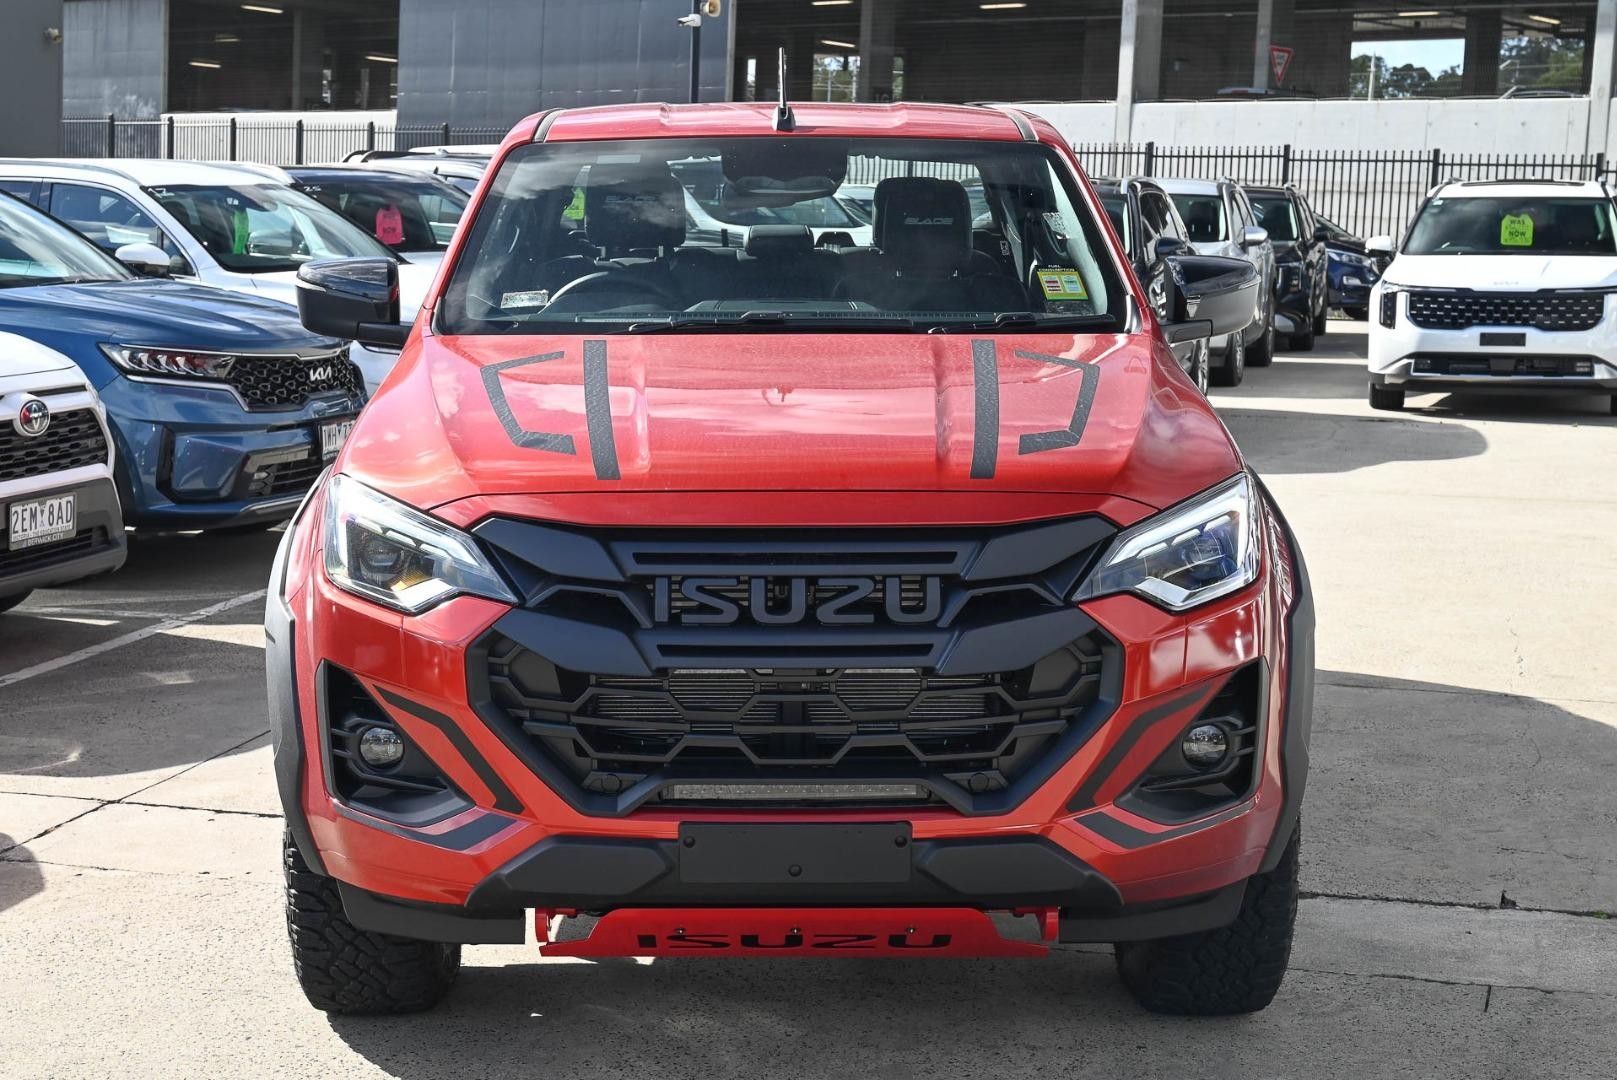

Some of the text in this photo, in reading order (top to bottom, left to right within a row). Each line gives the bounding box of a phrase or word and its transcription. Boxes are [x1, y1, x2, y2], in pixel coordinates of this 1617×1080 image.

[904, 217, 954, 225] BLADE
[310, 366, 332, 381] KIA
[12, 500, 73, 534] 2EM 8AD
[52, 532, 64, 541] CITY
[654, 576, 941, 624] ISUZU
[637, 934, 952, 949] ISUZU
